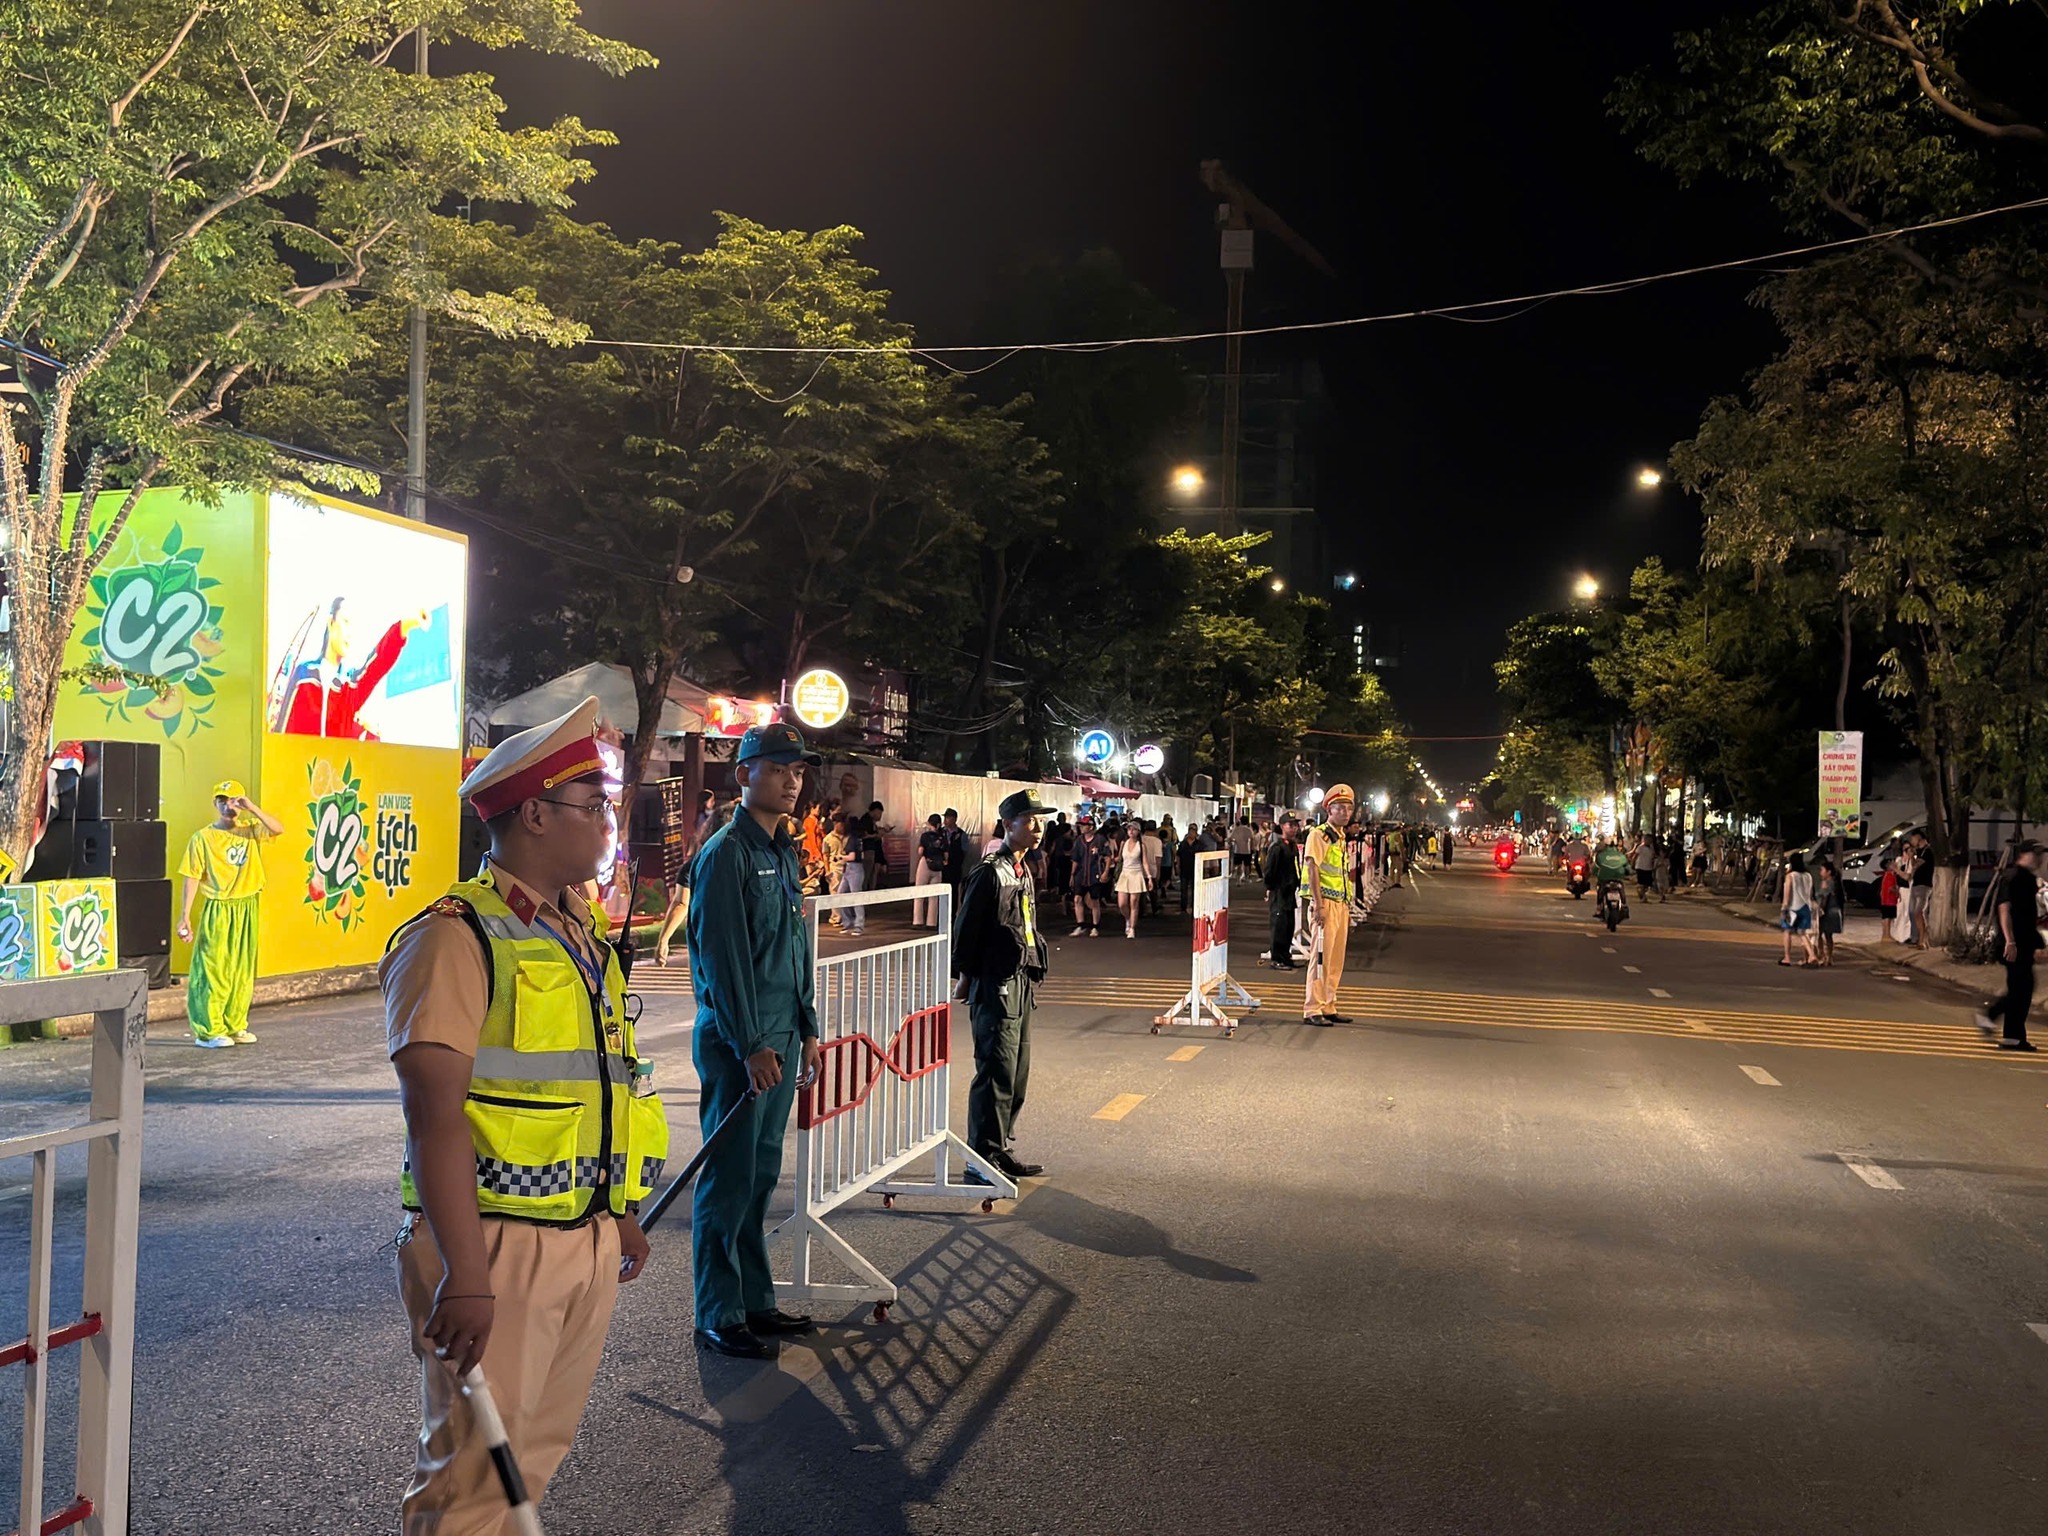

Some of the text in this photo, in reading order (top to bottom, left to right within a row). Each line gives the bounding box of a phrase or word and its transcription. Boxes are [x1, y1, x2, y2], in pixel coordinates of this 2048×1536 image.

[104, 577, 204, 677] C2
[1087, 738, 1108, 755] A1
[378, 795, 412, 810] LAN VIBE
[315, 802, 361, 886] C2
[377, 811, 417, 856] tích
[373, 850, 410, 898] cực
[0, 914, 20, 960] 2
[63, 905, 101, 959] C2
